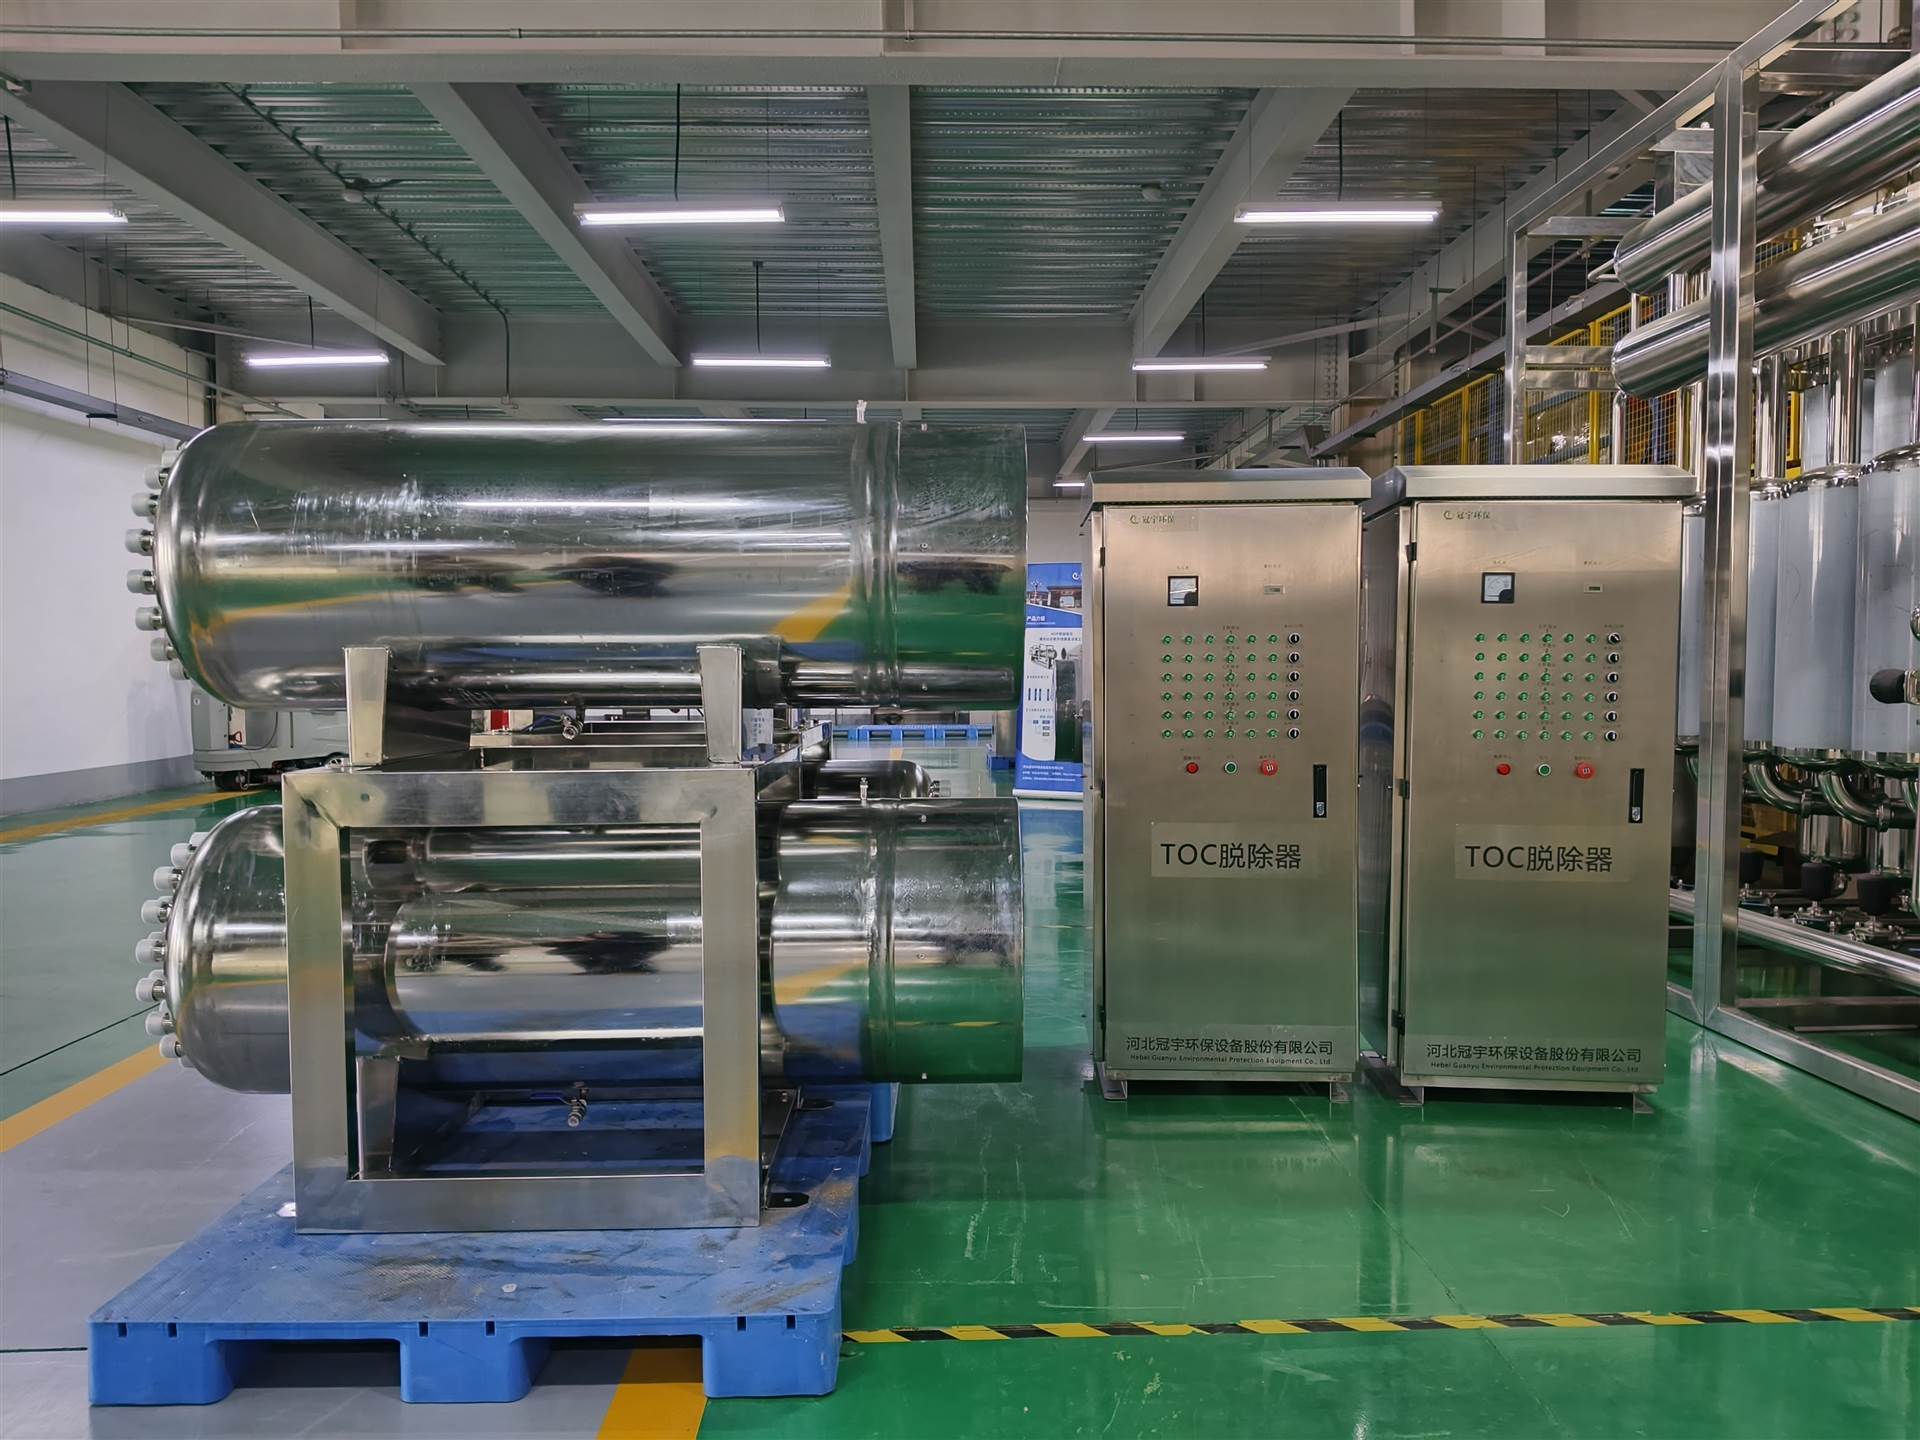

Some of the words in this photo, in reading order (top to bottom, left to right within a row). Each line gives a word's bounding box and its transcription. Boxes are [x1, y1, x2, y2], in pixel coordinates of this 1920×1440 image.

[1160, 842, 1302, 870] TOC脱除器
[1464, 845, 1613, 873] TOC脱除器
[1126, 1036, 1334, 1056] 河北冠宇环保设备股份有限公司
[1426, 1043, 1642, 1063] 河北冠宇环保设备股份有限公司
[1179, 1055, 1228, 1063] Environmental
[1229, 1056, 1264, 1064] Protection
[1266, 1057, 1303, 1066] Equipment
